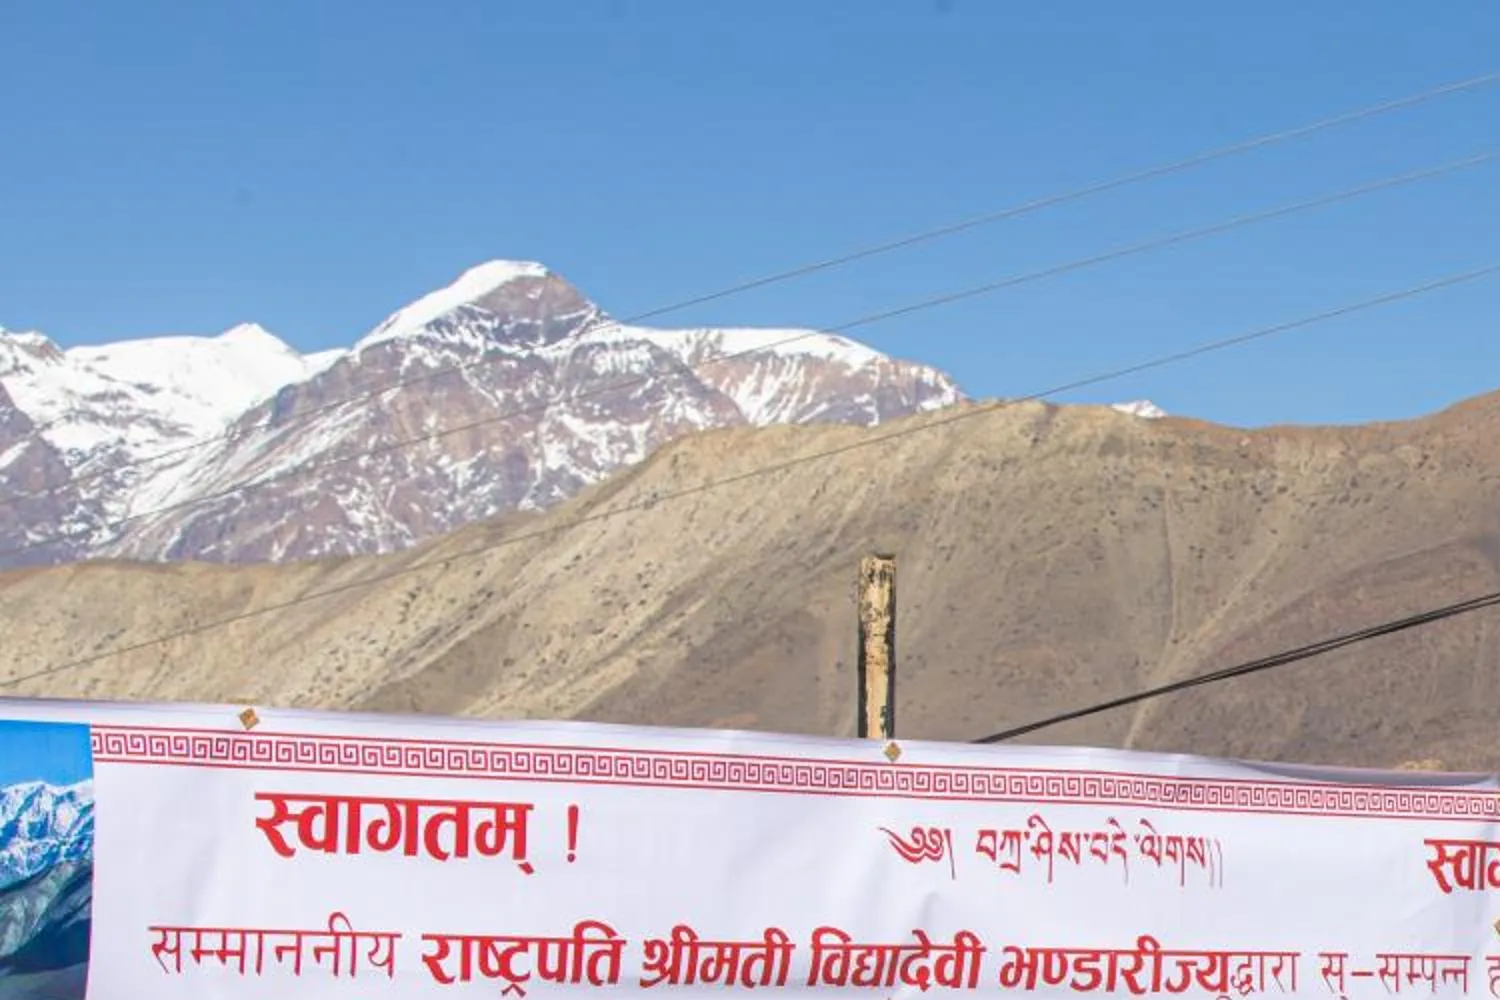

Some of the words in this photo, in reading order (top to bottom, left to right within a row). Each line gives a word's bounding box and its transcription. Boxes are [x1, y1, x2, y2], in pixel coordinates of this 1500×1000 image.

[253, 790, 533, 875] स्वागतम्
[149, 911, 402, 981] सम्माननीय
[419, 918, 629, 1000] राष्ट्रपति
[638, 920, 797, 992] श्रीमती
[805, 924, 989, 993] विद्यादेवी
